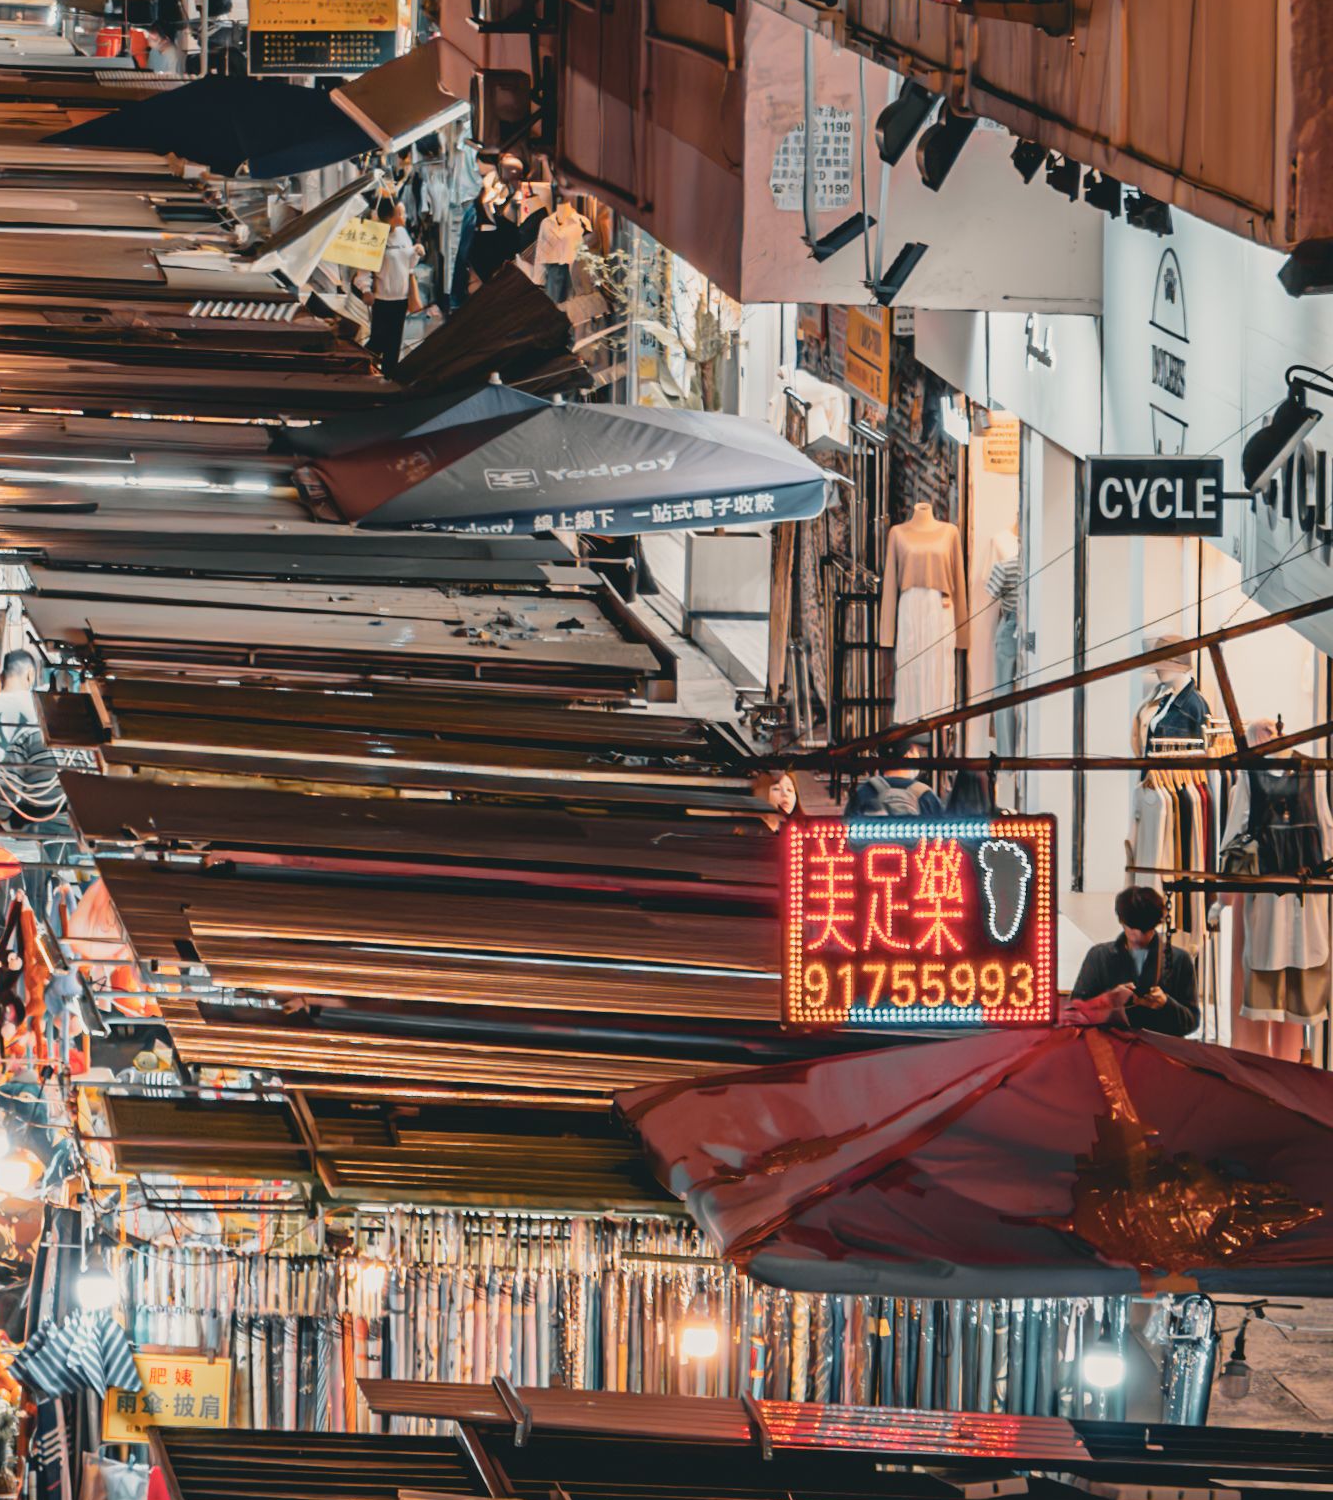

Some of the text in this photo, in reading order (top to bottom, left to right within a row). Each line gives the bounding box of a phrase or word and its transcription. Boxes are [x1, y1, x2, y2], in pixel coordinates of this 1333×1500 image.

[545, 451, 679, 482] Yedpay
[533, 493, 776, 532] 線上線下 一站式電子收款
[1098, 477, 1217, 519] CYCLE
[805, 836, 965, 956] 美足樂
[804, 962, 1035, 1009] 91755993
[148, 1367, 195, 1387] 肥姨
